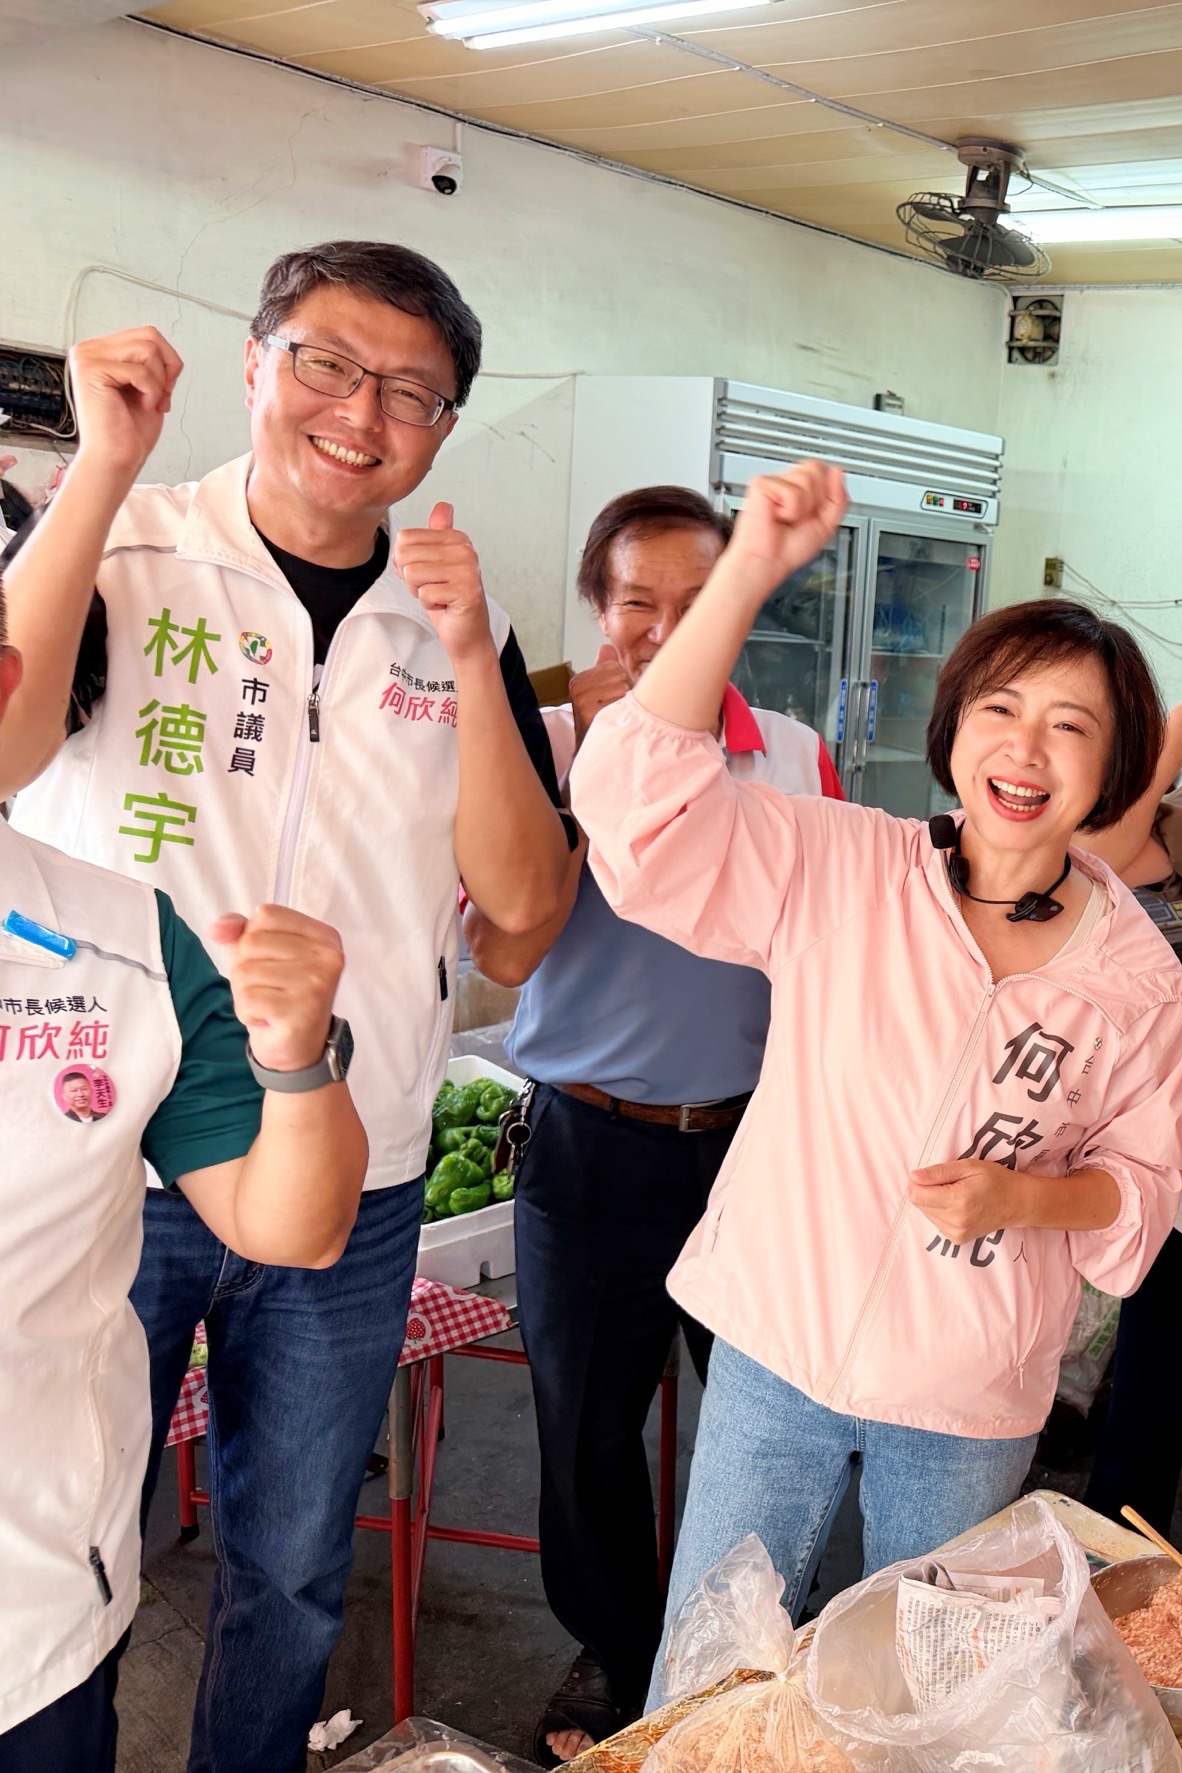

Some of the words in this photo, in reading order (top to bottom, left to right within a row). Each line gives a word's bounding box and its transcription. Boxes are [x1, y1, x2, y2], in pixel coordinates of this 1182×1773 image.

[389, 662, 458, 693] 台中市長候選
[118, 607, 222, 864] 林德宇
[227, 677, 270, 777] 市議員
[0, 995, 107, 1016] 市長候選人
